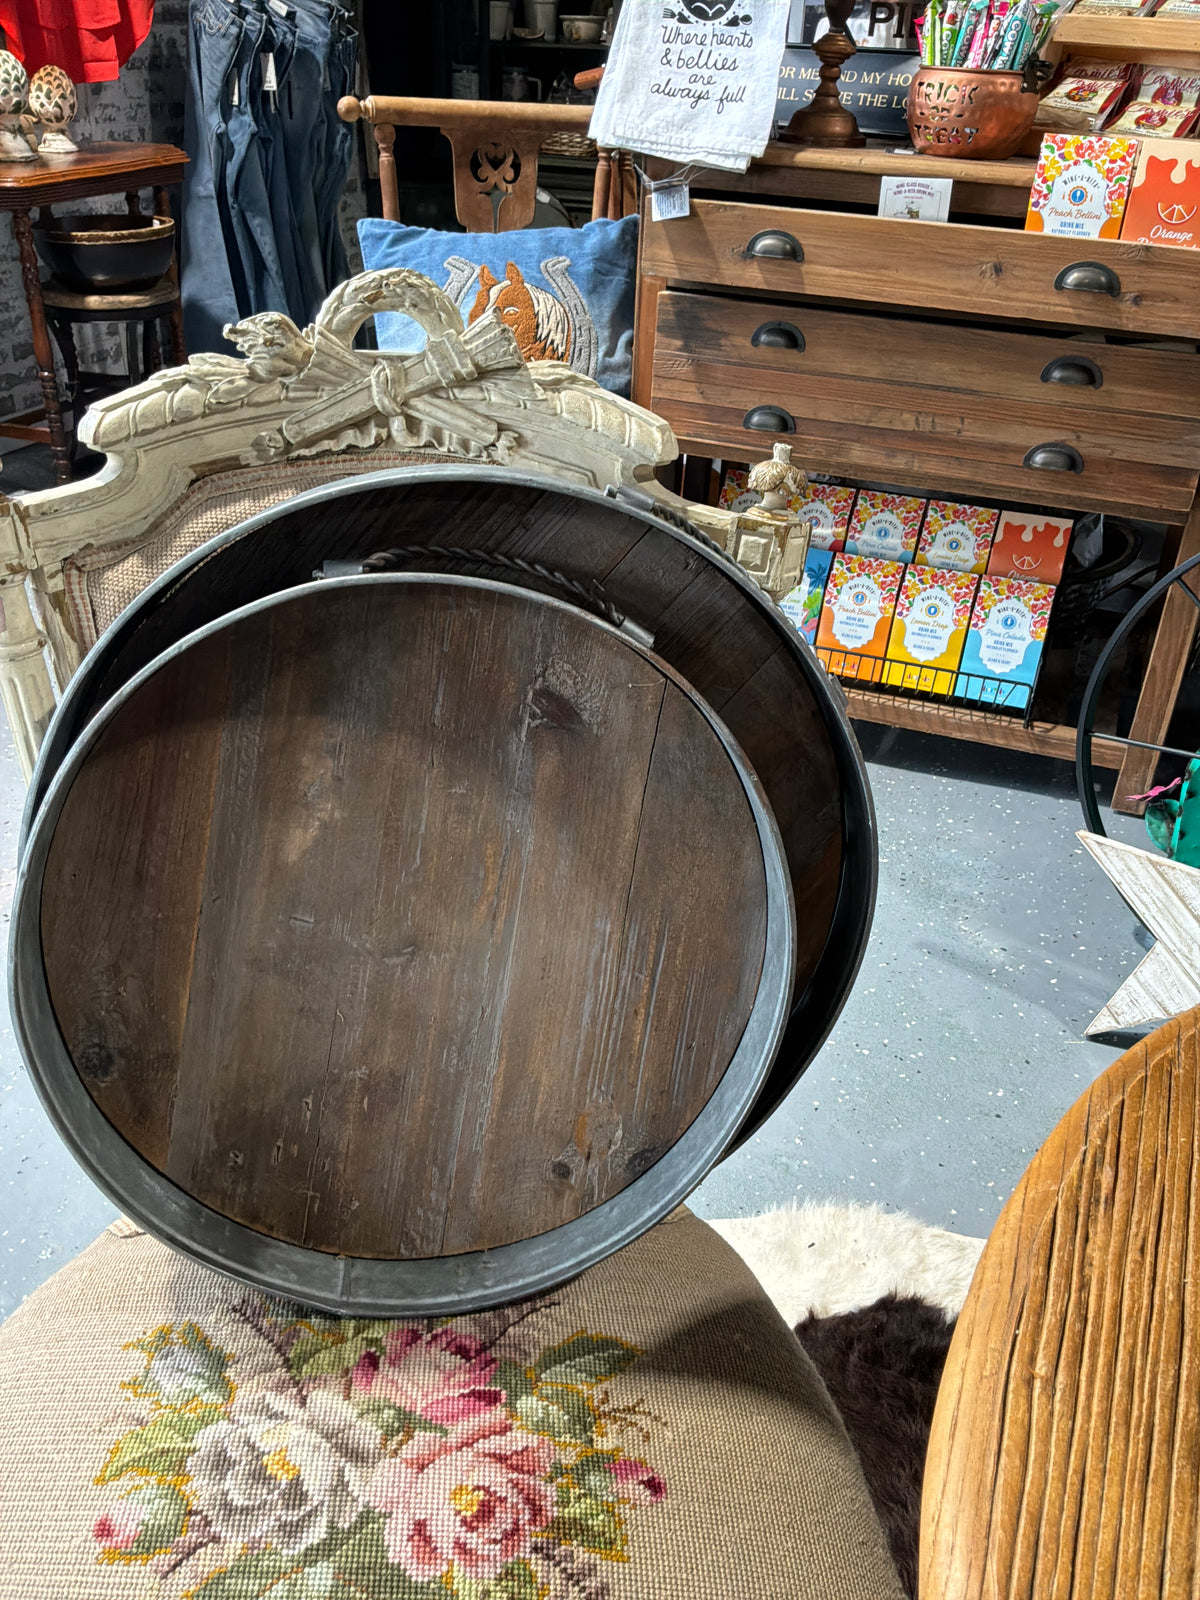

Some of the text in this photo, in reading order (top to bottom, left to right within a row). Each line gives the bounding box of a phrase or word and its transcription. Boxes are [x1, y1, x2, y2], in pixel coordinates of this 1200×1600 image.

[661, 25, 753, 48] Where hearts
[660, 47, 739, 71] & bellies
[688, 73, 717, 86] are
[779, 65, 796, 79] OR
[798, 67, 820, 80] ME
[840, 70, 858, 83] ND
[860, 71, 885, 85] MY
[650, 77, 747, 115] always full
[777, 87, 799, 101] ILL
[857, 92, 889, 108] THE
[917, 81, 979, 105] TRICK
[914, 124, 980, 145] TREAT
[1048, 206, 1103, 221] Peach Bellini
[1150, 224, 1193, 243] Orange
[837, 604, 856, 614] Peach
[910, 617, 949, 632] Lemon Drop
[1002, 631, 1026, 642] Colada
